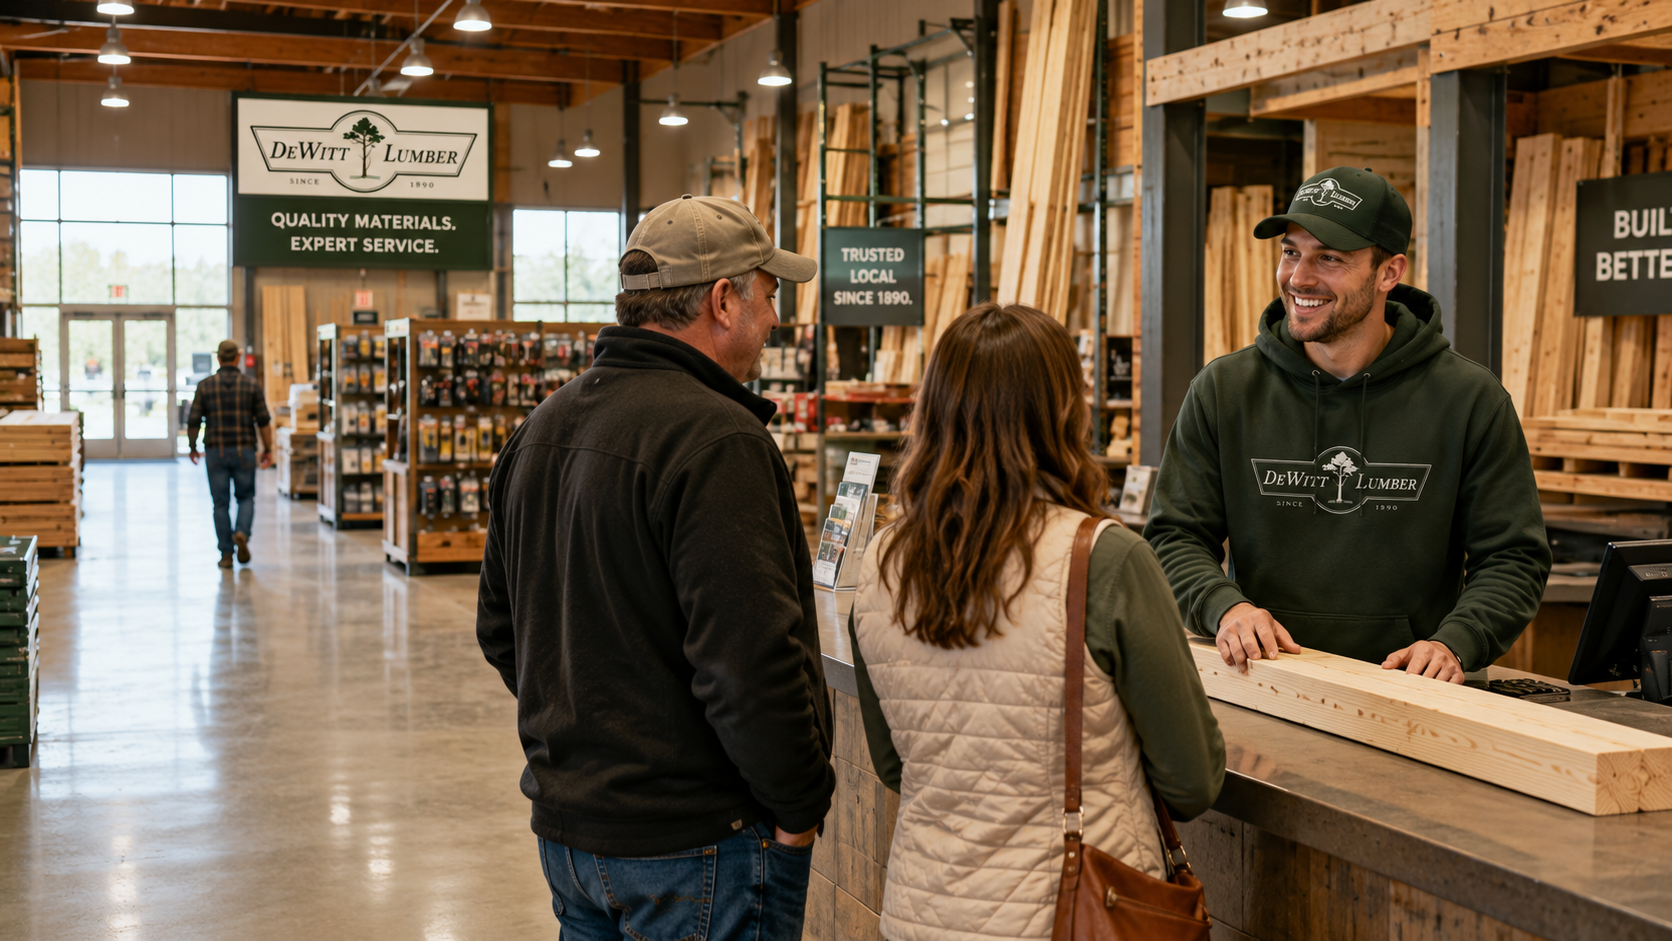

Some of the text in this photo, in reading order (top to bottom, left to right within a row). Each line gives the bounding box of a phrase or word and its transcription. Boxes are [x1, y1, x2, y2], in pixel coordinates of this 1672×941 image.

[383, 144, 458, 165] LUMBER
[289, 178, 435, 189] SINCE 1890
[271, 211, 457, 231] QUALITY MATERIALS.
[1613, 207, 1672, 239] BUIL
[290, 236, 440, 254] EXPERT SERVICE.
[840, 247, 905, 263] TRUSTED
[849, 268, 898, 284] LOCAL
[833, 290, 913, 306] SINCE 1890.
[1354, 472, 1418, 491] LUMBER
[1276, 500, 1303, 508] SINCE
